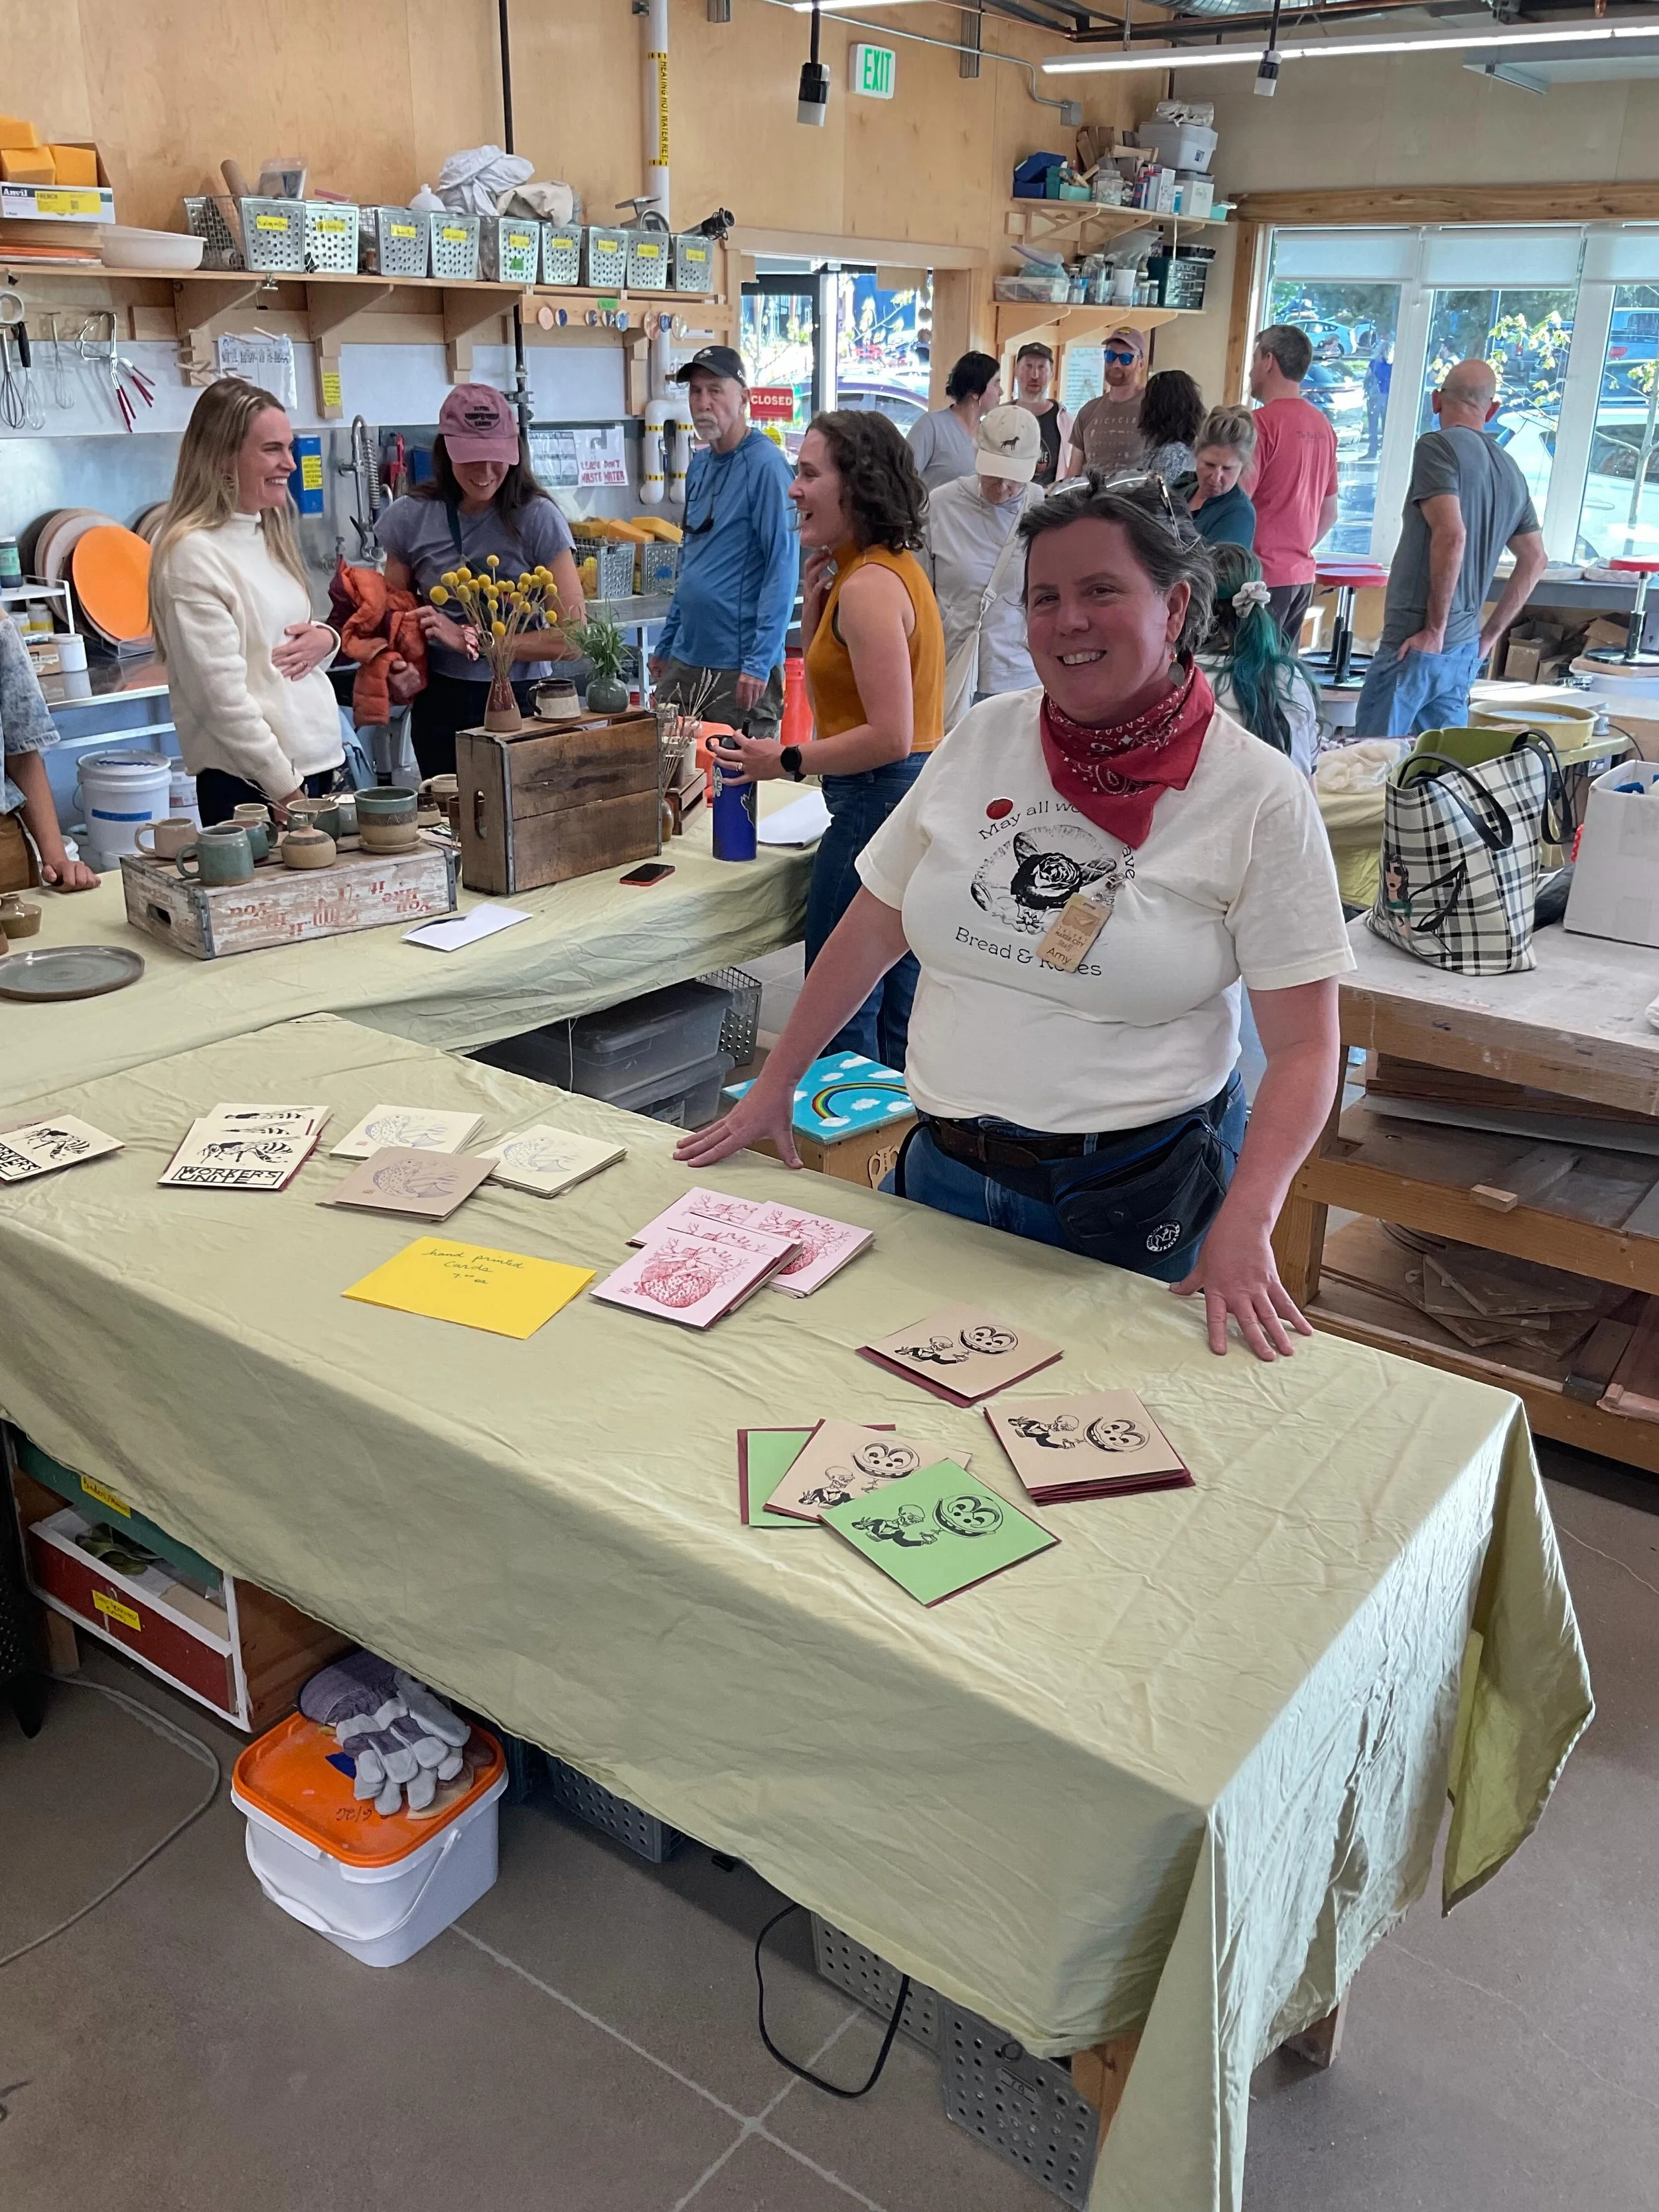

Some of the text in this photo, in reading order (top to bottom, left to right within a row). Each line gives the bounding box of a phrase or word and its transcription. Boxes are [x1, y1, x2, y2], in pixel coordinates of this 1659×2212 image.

[863, 48, 892, 93] EXIT
[660, 115, 669, 141] WATER
[3, 188, 28, 196] Anvil
[751, 395, 793, 406] CLOSED
[605, 471, 624, 482] WATER
[978, 813, 1021, 840] May
[1027, 800, 1048, 816] all
[1122, 846, 1135, 879] ave
[955, 926, 1011, 959] Bread
[1017, 948, 1034, 964] &
[1055, 930, 1085, 947] MAKER CITY
[1057, 939, 1074, 952] Staff
[1046, 948, 1072, 965] Amy
[179, 1173, 250, 1184] UNITE
[421, 1249, 524, 1269] hand printed
